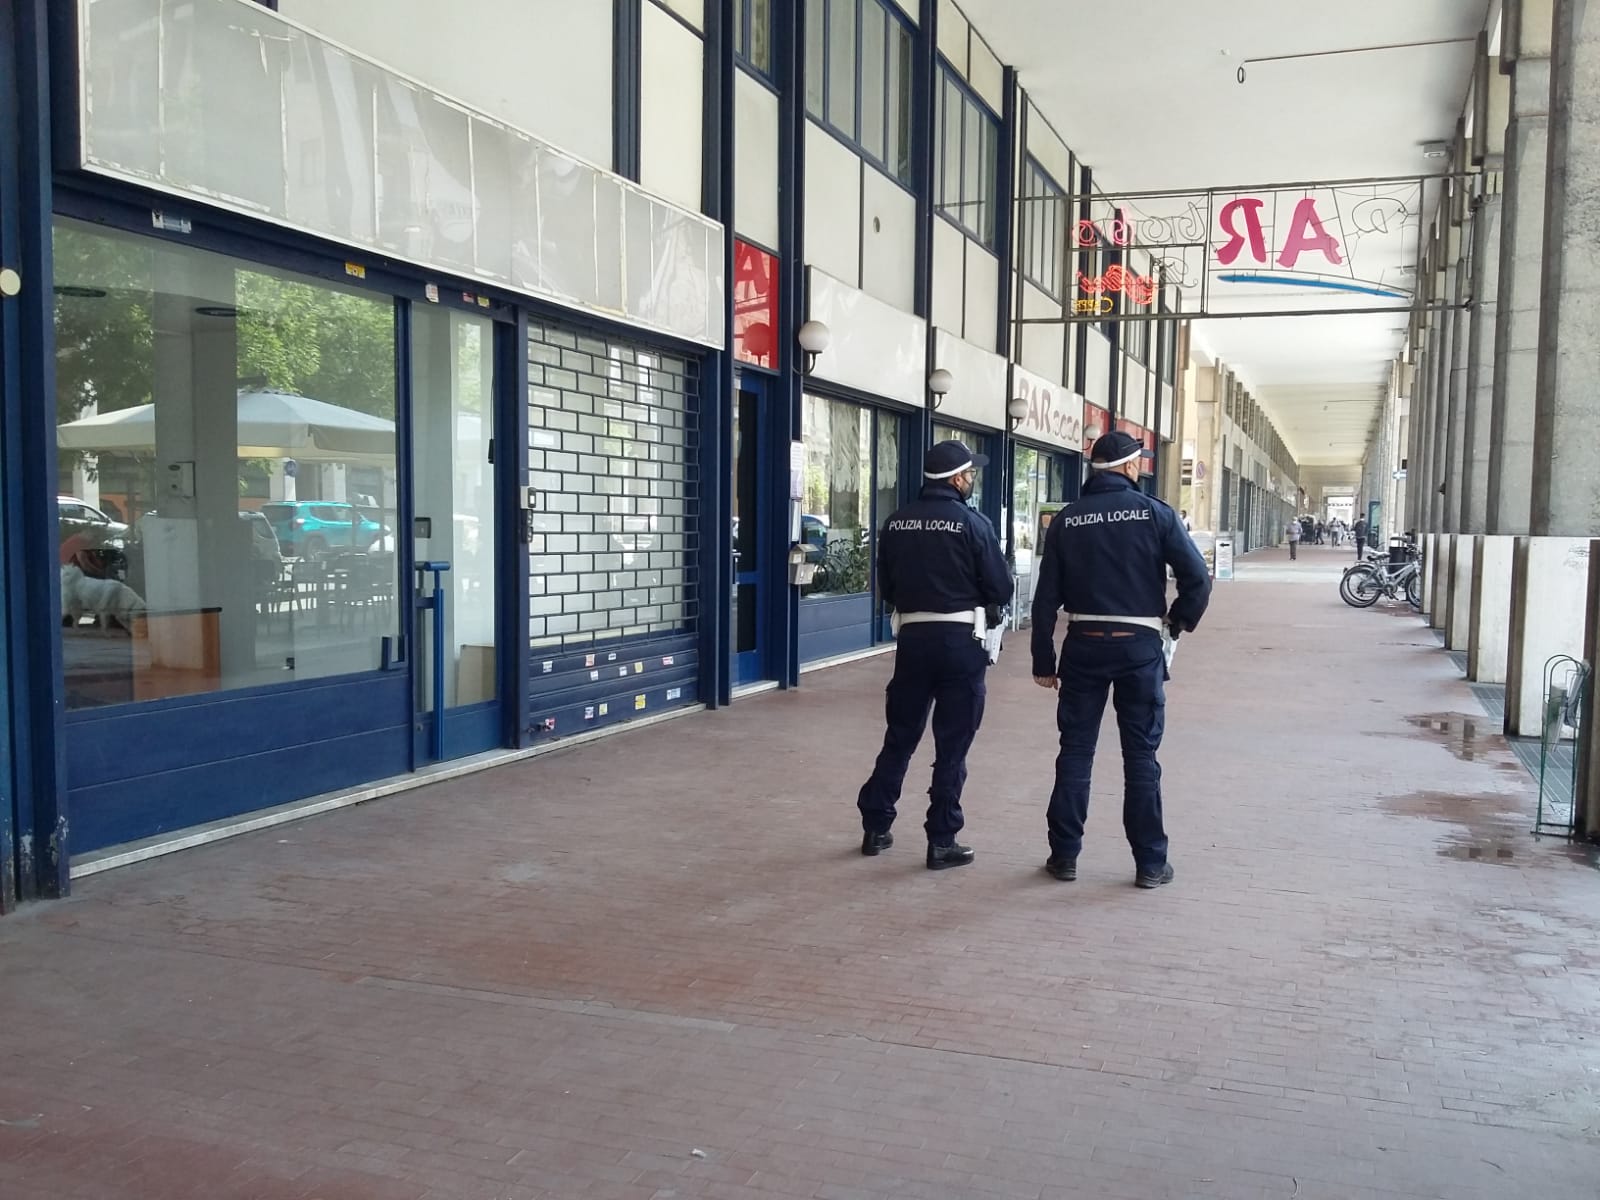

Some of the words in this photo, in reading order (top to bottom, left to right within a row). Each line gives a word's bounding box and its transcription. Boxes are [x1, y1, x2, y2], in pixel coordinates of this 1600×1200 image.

[888, 519, 922, 532] POLIZIA
[925, 520, 964, 534] LOCALE
[1064, 512, 1103, 529] POLIZIA
[1106, 508, 1150, 523] LOCALE
